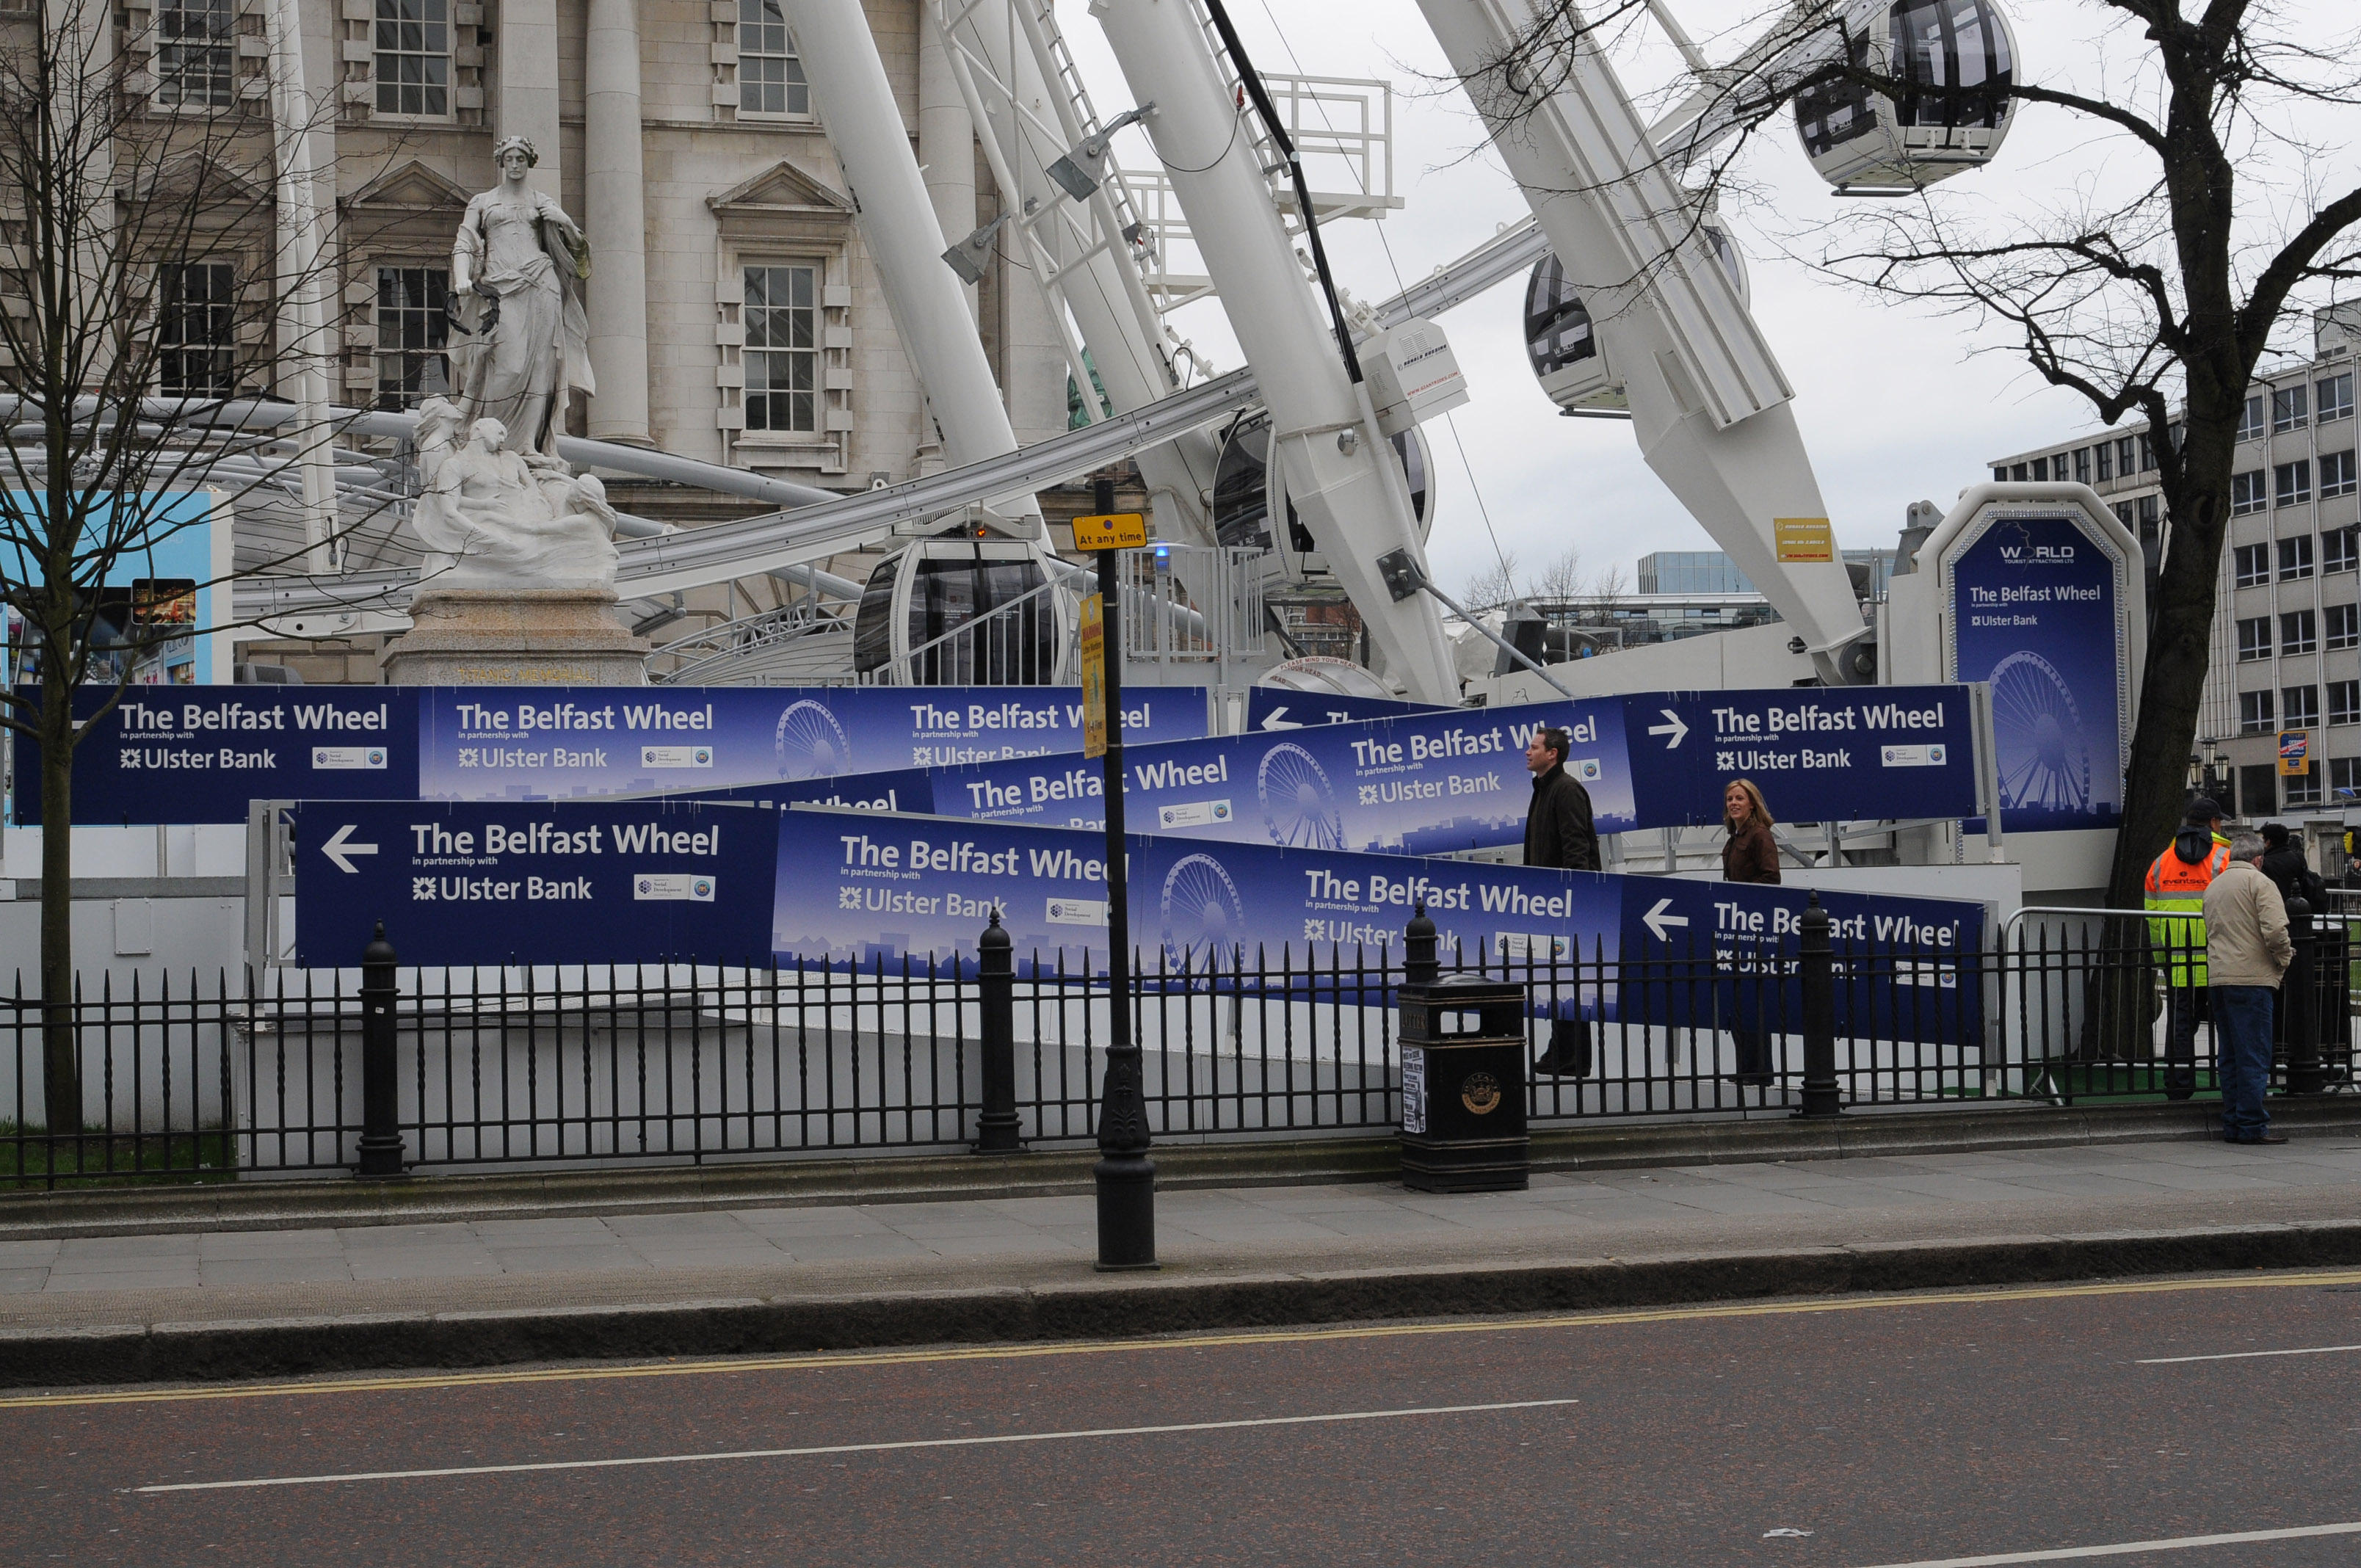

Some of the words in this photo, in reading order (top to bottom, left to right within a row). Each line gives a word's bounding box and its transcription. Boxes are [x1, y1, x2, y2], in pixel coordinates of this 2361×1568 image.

[1829, 119, 1852, 135] WRLD
[1553, 343, 1575, 355] WRLD
[1080, 535, 1092, 545] At
[1097, 535, 1115, 545] any
[1120, 531, 1142, 542] time
[1238, 535, 1255, 547] WRLD
[1970, 587, 1997, 601] The
[2002, 586, 2050, 601] Belfast
[2055, 585, 2100, 600] Wheel
[1982, 616, 2011, 625] Ulster
[2014, 615, 2037, 625] Bank
[1280, 659, 1302, 670] PLEASE
[1340, 660, 1357, 669] HEAD
[1305, 668, 1321, 677] HEAD
[458, 668, 512, 681] TITANIC
[518, 668, 594, 681] MEMORIAL
[119, 703, 173, 729] The
[184, 703, 284, 729] Belfast
[294, 704, 386, 730] Wheel
[457, 704, 509, 729] The
[519, 704, 614, 729] Belfast
[623, 704, 712, 729] Wheel
[910, 704, 960, 729] The
[969, 703, 1059, 729] Belfast
[1066, 703, 1150, 728] Wel
[1712, 708, 1760, 733] The
[1769, 705, 1856, 731] Belfast
[1863, 703, 1943, 729] Wheel
[130, 732, 174, 740] partnership
[468, 731, 510, 740] partnership
[921, 730, 961, 739] partnership
[1724, 734, 1762, 744] partnership
[1351, 738, 1402, 766] The
[1410, 727, 1504, 761] Belfast
[145, 749, 214, 768] Ulster
[220, 749, 276, 768] Bank
[482, 749, 548, 767] Ulster
[554, 748, 607, 767] Bank
[935, 747, 995, 766] Ulster
[1738, 751, 1796, 770] Ulster
[1802, 749, 1851, 768] Bank
[1365, 765, 1405, 776] partnership
[1407, 762, 1424, 770] with
[966, 780, 1021, 809] The
[1030, 770, 1129, 802] Belfat
[1136, 755, 1227, 791] Wheel
[1381, 780, 1443, 802] Ulster
[1448, 772, 1501, 795] Bank
[972, 810, 979, 819] in
[981, 807, 1024, 819] partnership
[1026, 805, 1043, 813] with
[410, 823, 474, 854] The
[487, 823, 601, 854] Belfast
[612, 823, 718, 855] Wheel
[413, 857, 421, 865] in
[424, 857, 475, 867] partnership
[477, 857, 497, 865] with
[841, 835, 899, 867] The
[911, 841, 1019, 876] Belfast
[841, 866, 848, 875] in
[851, 868, 899, 879] partnership
[900, 871, 921, 880] with
[442, 877, 521, 900] Ulster
[528, 876, 592, 899] Bank
[1305, 869, 1359, 901] The
[1369, 875, 1470, 910] Belfast
[1480, 884, 1572, 918] Wheel
[866, 888, 940, 913] Ulster
[947, 893, 1007, 918] Bank
[1305, 900, 1313, 908] in
[1314, 901, 1360, 913] partnership
[1361, 904, 1379, 913] with
[1714, 902, 1763, 932] The
[1773, 907, 1865, 940] Beast
[1330, 921, 1397, 947] Ulster
[1404, 923, 1457, 952] nk
[1714, 931, 1722, 939] in
